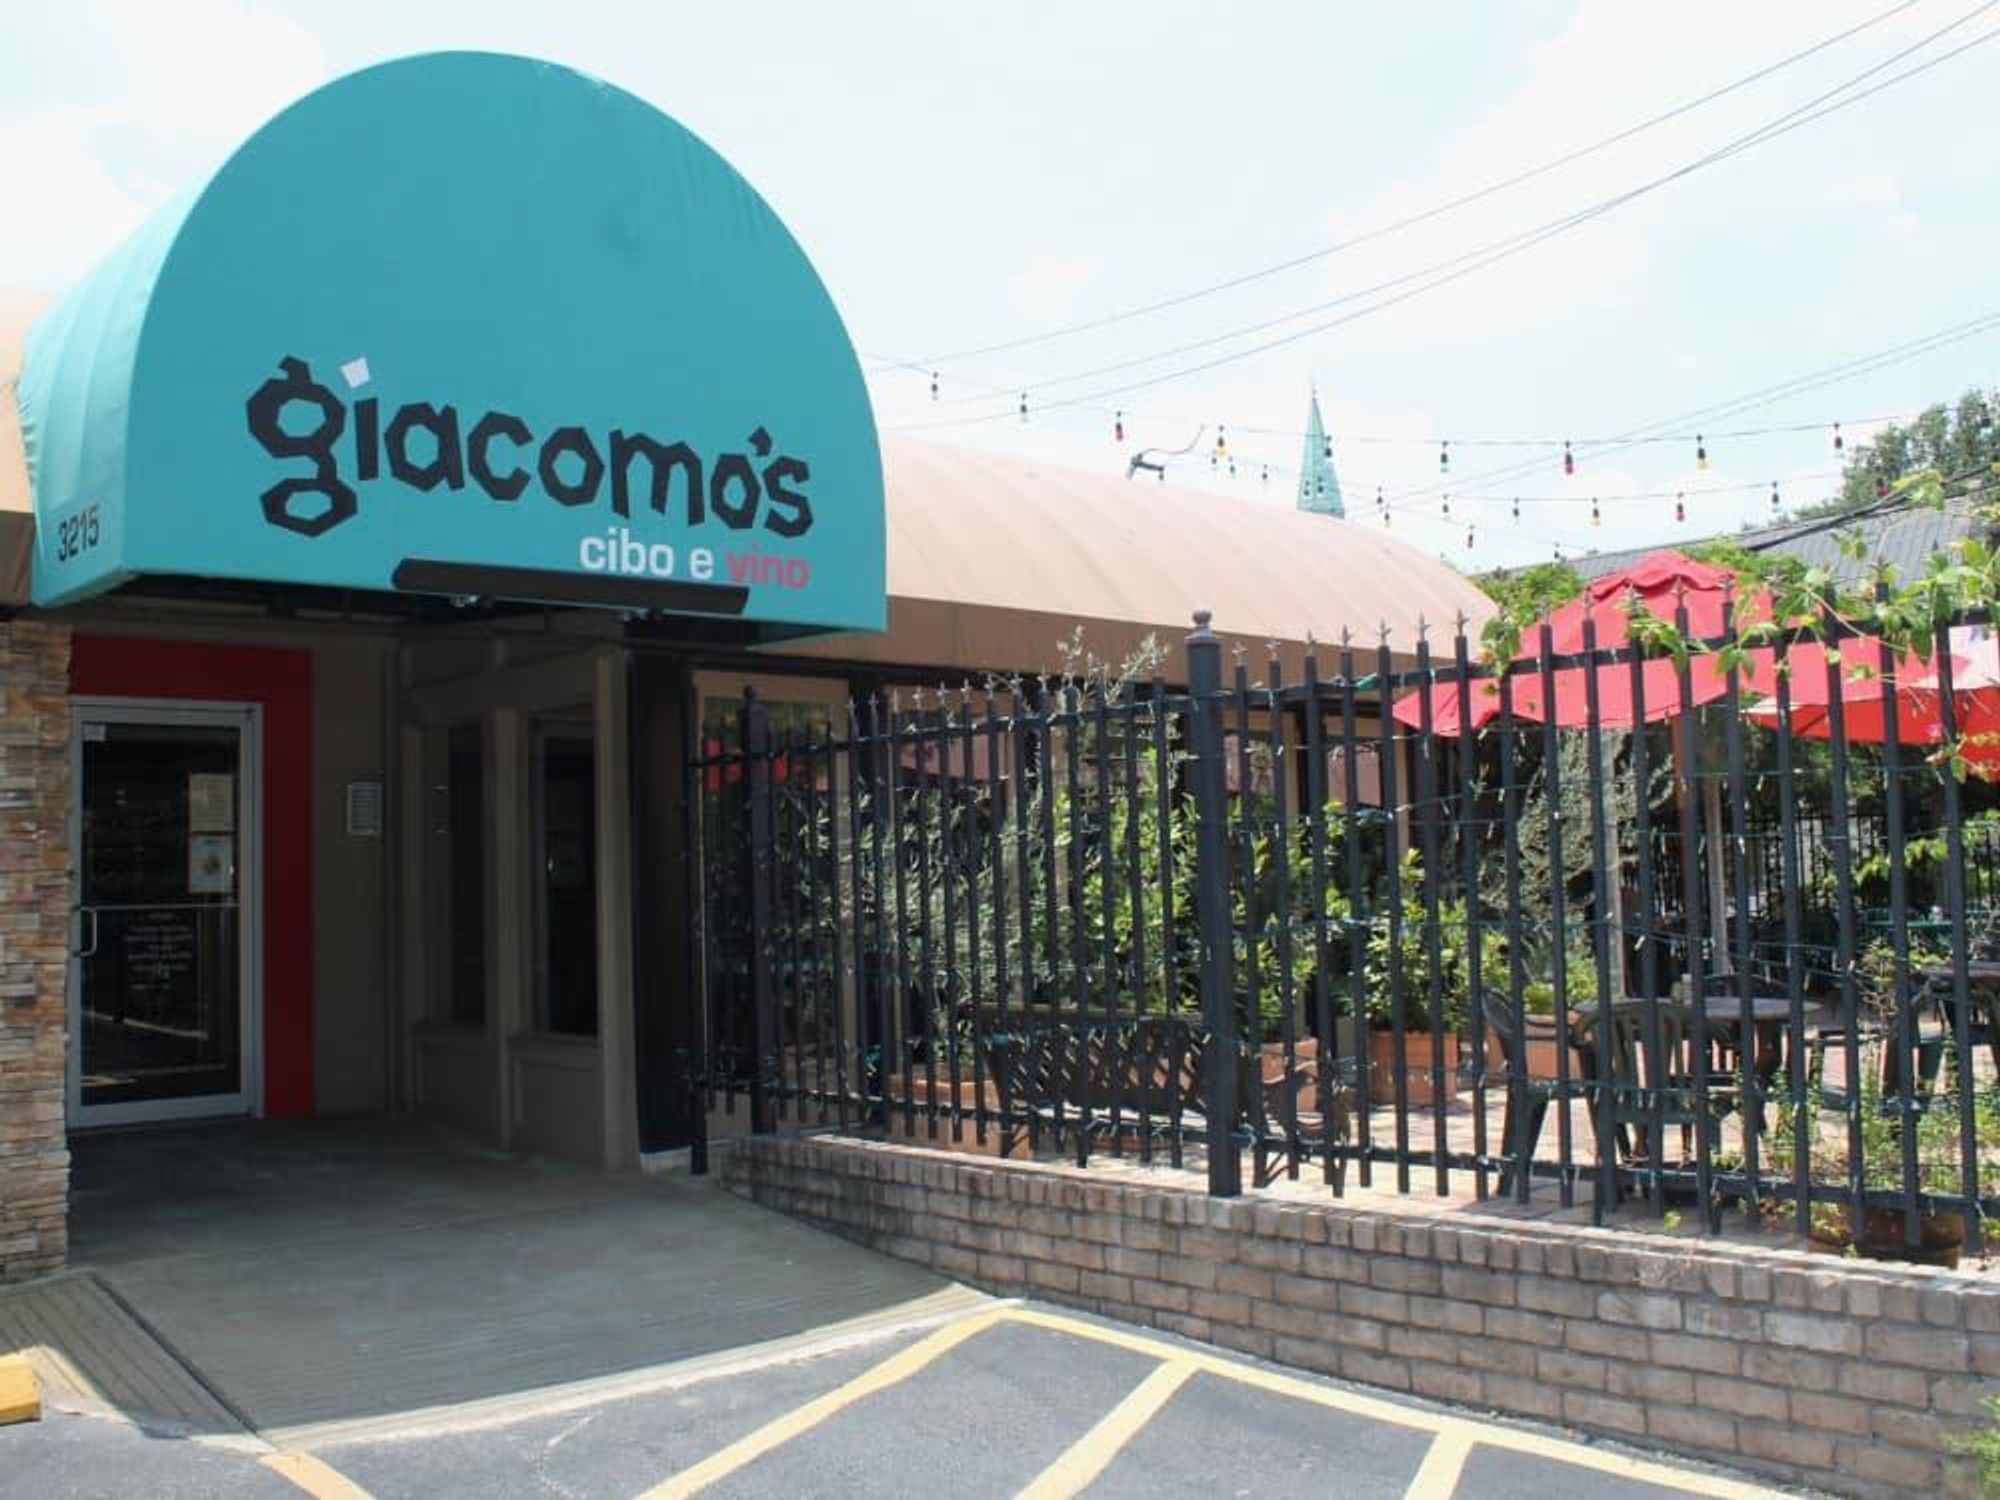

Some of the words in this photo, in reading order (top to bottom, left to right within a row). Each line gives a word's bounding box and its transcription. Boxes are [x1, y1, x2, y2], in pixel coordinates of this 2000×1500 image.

[246, 355, 814, 538] giacomo's
[58, 504, 100, 562] 3215
[579, 526, 675, 577] cibo
[688, 547, 714, 580] e
[726, 545, 810, 588] vino
